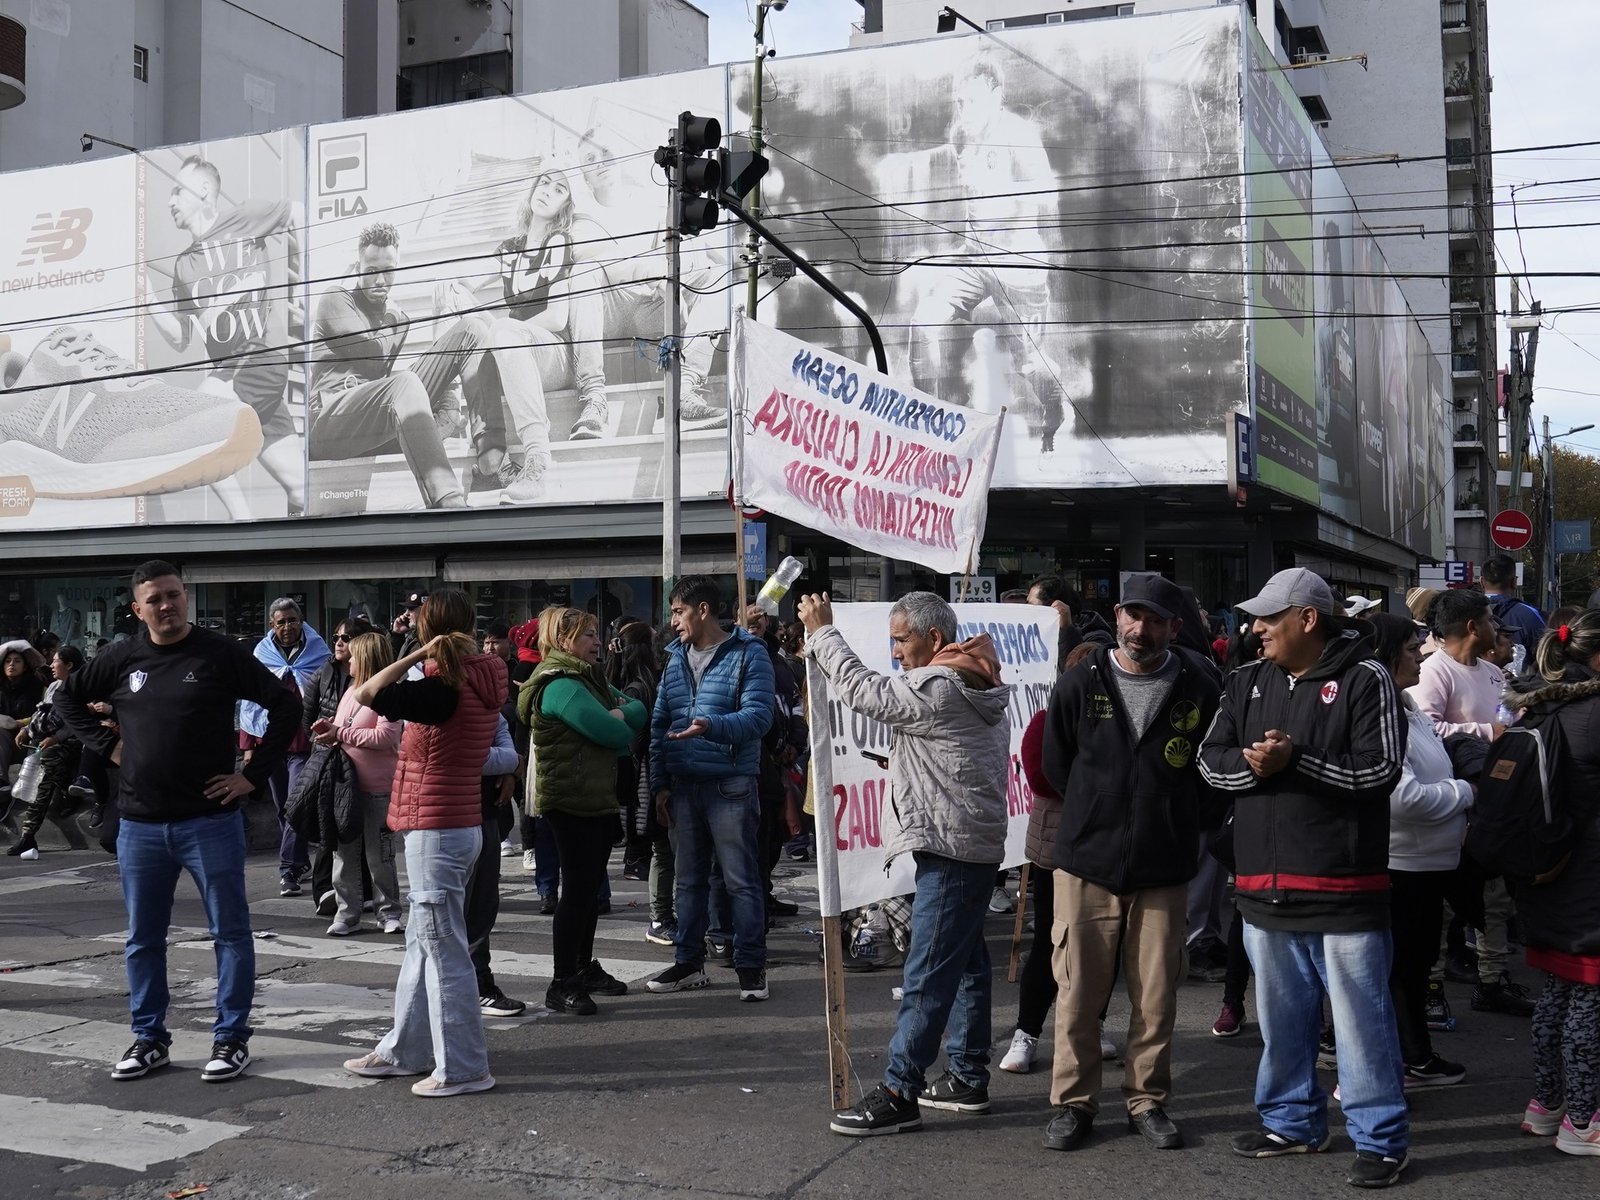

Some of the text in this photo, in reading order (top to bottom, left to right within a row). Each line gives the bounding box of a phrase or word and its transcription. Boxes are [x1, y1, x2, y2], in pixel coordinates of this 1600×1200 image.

[318, 195, 368, 220] FILA
[201, 235, 259, 272] WE
[2, 267, 105, 293] new balance
[191, 271, 267, 309] GOT
[186, 307, 272, 345] NOW
[1238, 421, 1249, 475] E
[3, 498, 30, 508] FOAM
[1450, 562, 1464, 581] E
[982, 580, 992, 594] 9
